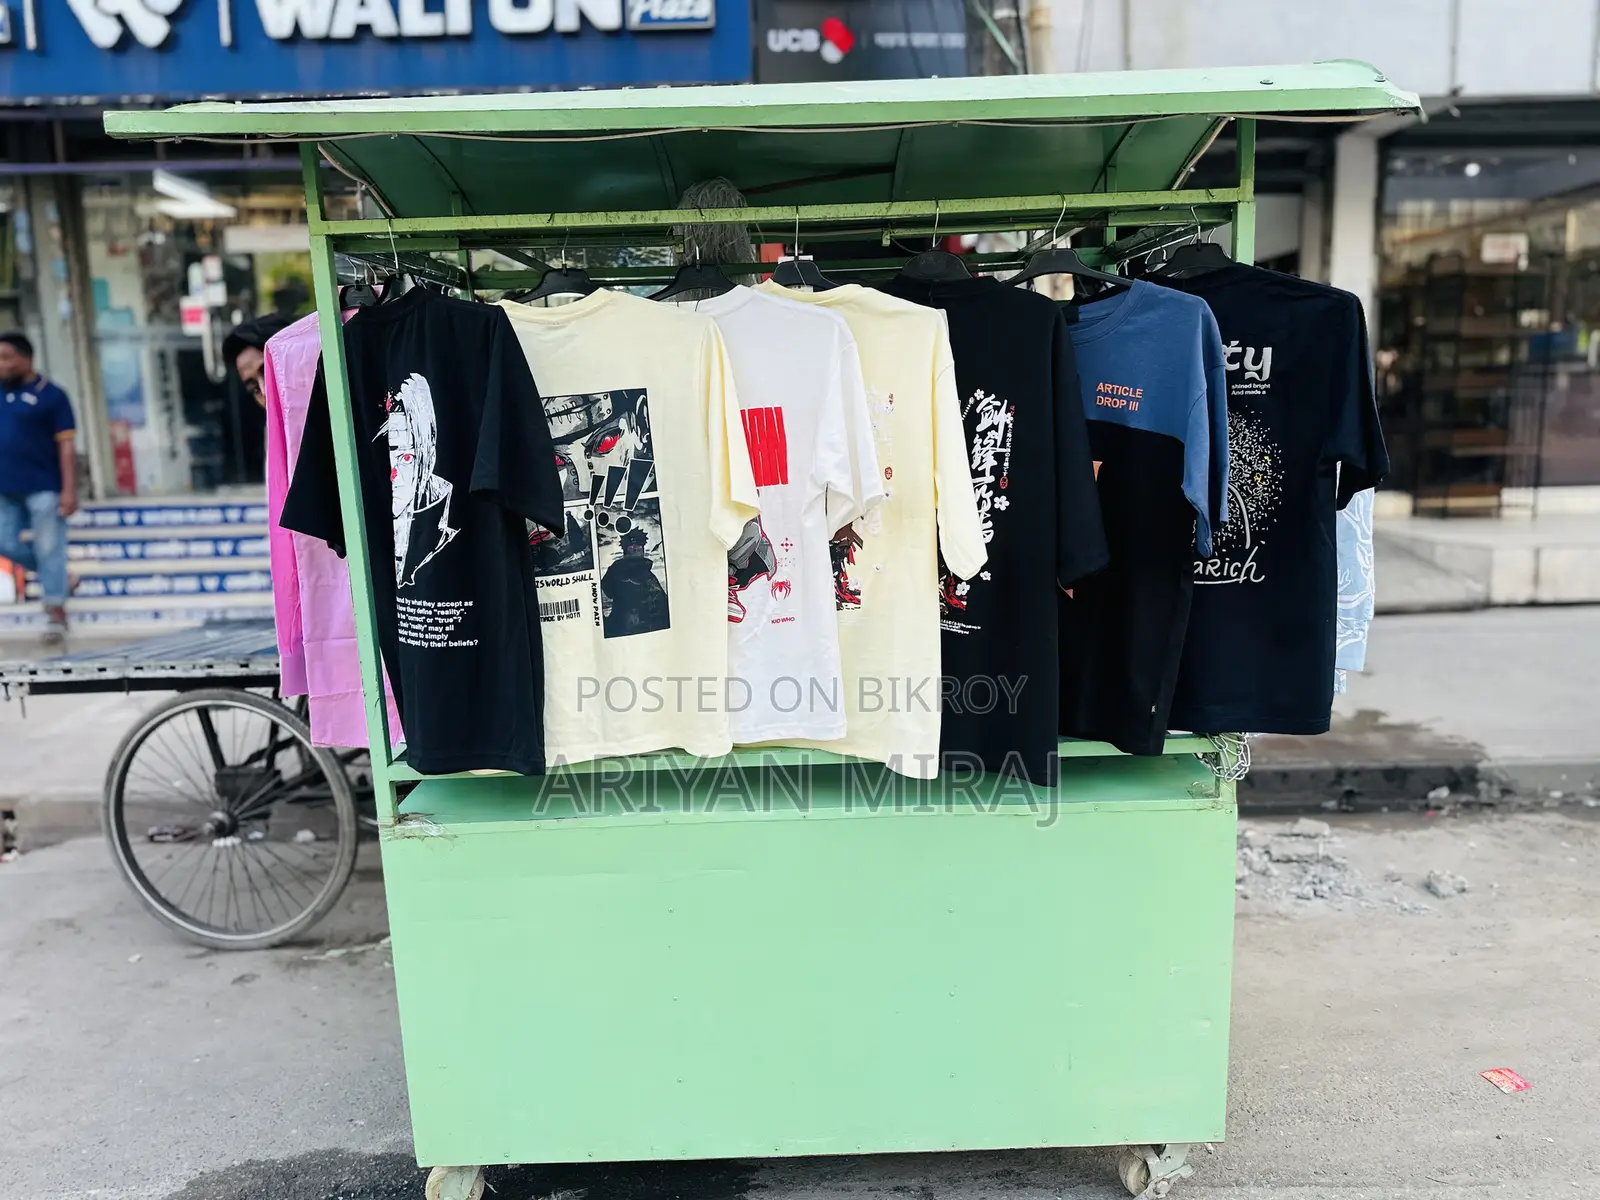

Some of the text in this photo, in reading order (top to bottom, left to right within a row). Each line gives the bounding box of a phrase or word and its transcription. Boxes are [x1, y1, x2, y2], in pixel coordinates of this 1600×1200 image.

[767, 28, 820, 52] UCB
[1096, 382, 1144, 398] ARTICLE
[1096, 395, 1139, 411] DROP III
[545, 577, 571, 588] WORLD
[572, 573, 594, 584] SHALL
[422, 600, 435, 609] they
[437, 600, 463, 608] accept
[425, 632, 448, 640] simply
[448, 639, 478, 647] beliefs?
